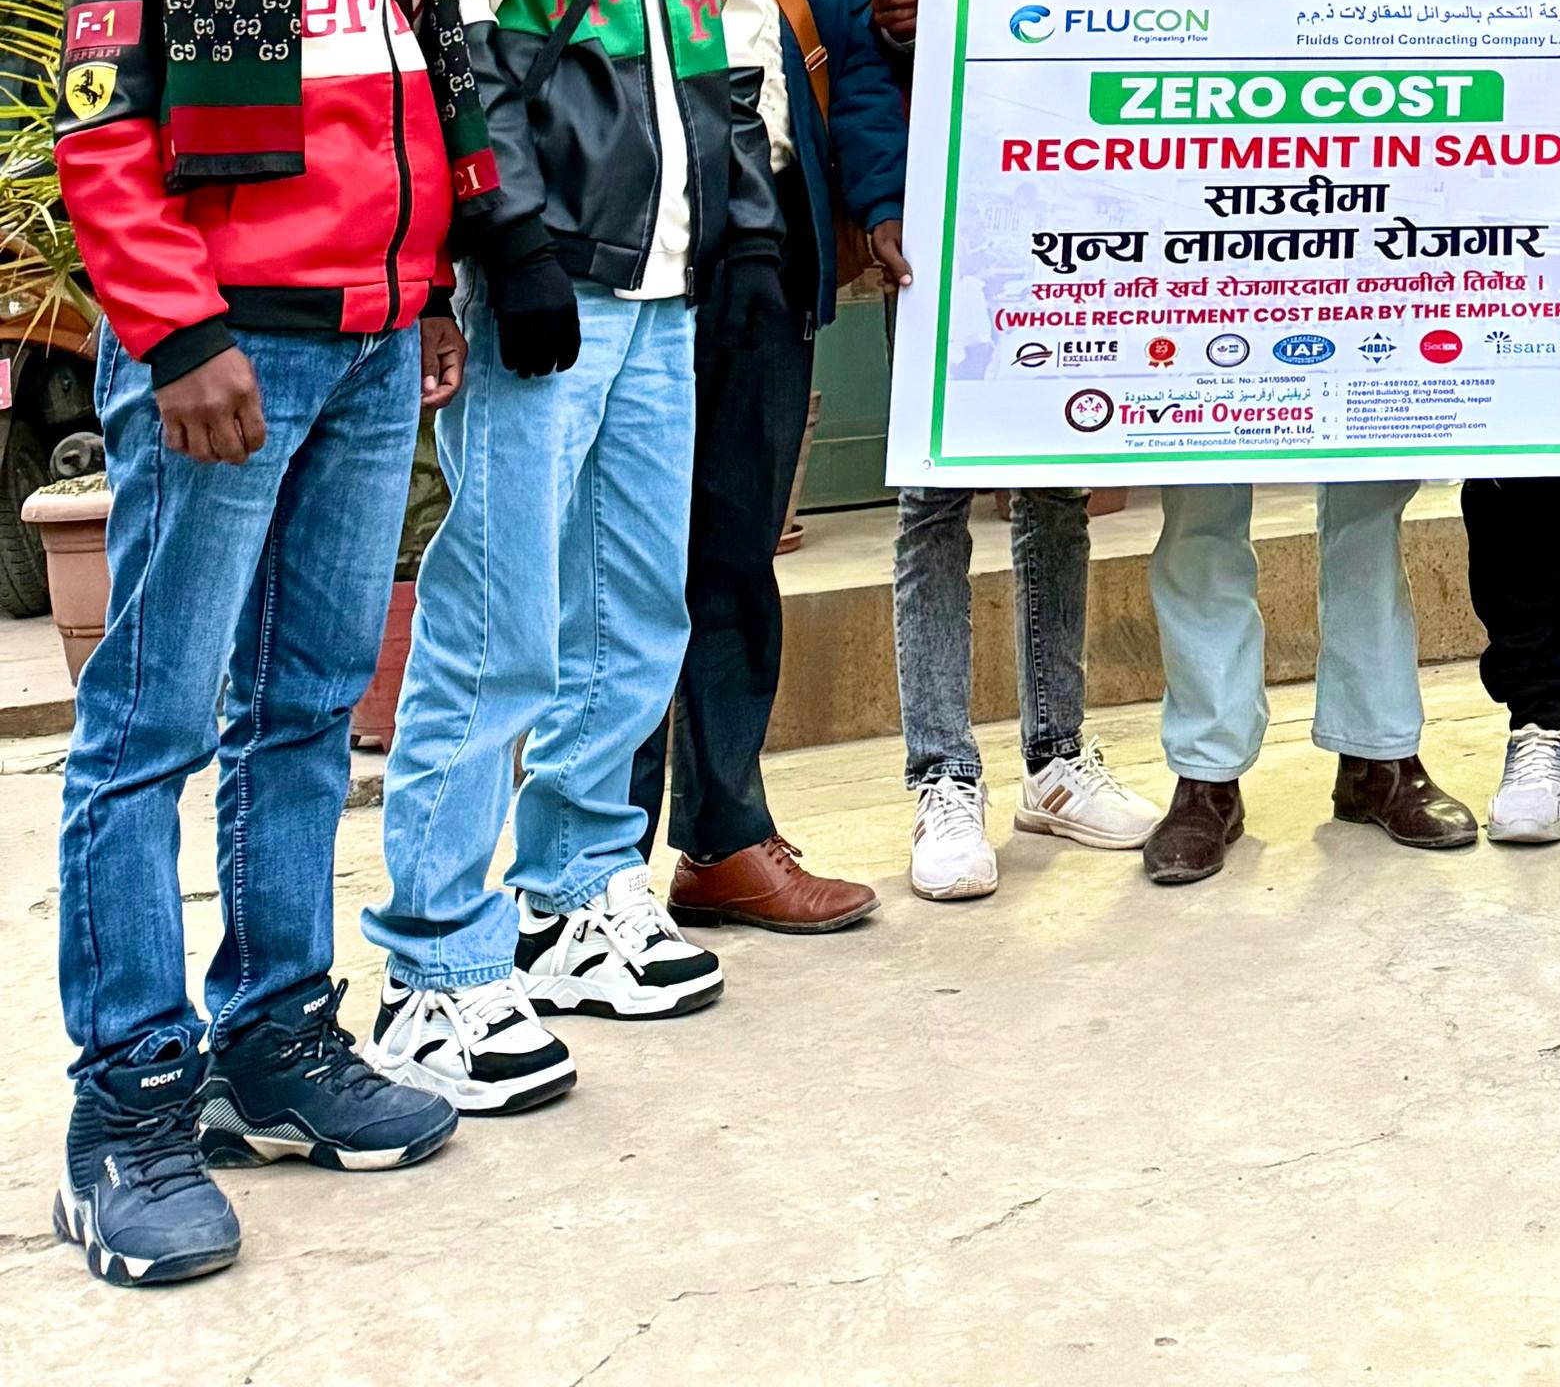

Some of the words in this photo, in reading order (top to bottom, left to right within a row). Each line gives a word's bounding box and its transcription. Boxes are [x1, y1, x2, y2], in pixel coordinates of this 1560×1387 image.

[75, 9, 115, 40] F-1
[1065, 9, 1209, 33] FLUCON
[1133, 35, 1184, 43] Engineering
[1296, 34, 1338, 45] Fluids
[1344, 34, 1394, 45] Control
[1398, 34, 1477, 47] Contracting
[1482, 34, 1545, 47] Company
[1119, 75, 1287, 119] ZERO
[1300, 74, 1473, 117] COST
[1001, 134, 1360, 172] RECRUITMENT
[1373, 134, 1420, 168] IN
[1204, 174, 1390, 217] साउदीमा
[1032, 231, 1149, 273] शुन्य
[1164, 228, 1359, 263] लागतमा
[1374, 216, 1548, 259] रोजगार
[1032, 277, 1105, 304] सम्पूर्ण
[1113, 275, 1157, 299] भर्ति
[1166, 276, 1208, 298] खर्च
[1217, 273, 1349, 298] रोजगारदाता
[1357, 272, 1455, 294] कम्पनीले
[995, 306, 1088, 330] (WHOLE
[1091, 306, 1249, 326] RECRUITMENT
[1252, 305, 1314, 323] COST
[1317, 305, 1376, 322] BEAR
[1379, 304, 1406, 320] BY
[1411, 302, 1449, 319] THE
[1063, 341, 1118, 354] ELITE
[1286, 344, 1325, 355] IAF
[1496, 339, 1556, 353] issara
[1119, 404, 1203, 424] Triveni
[1212, 403, 1313, 422] Overseas
[1234, 426, 1271, 435] Concern
[1274, 426, 1297, 435] Pvt.
[1300, 425, 1315, 434] Ltd.
[303, 993, 330, 1016] ROCKY
[140, 1067, 184, 1089] ROCKY
[103, 1155, 120, 1189] ROCKY
